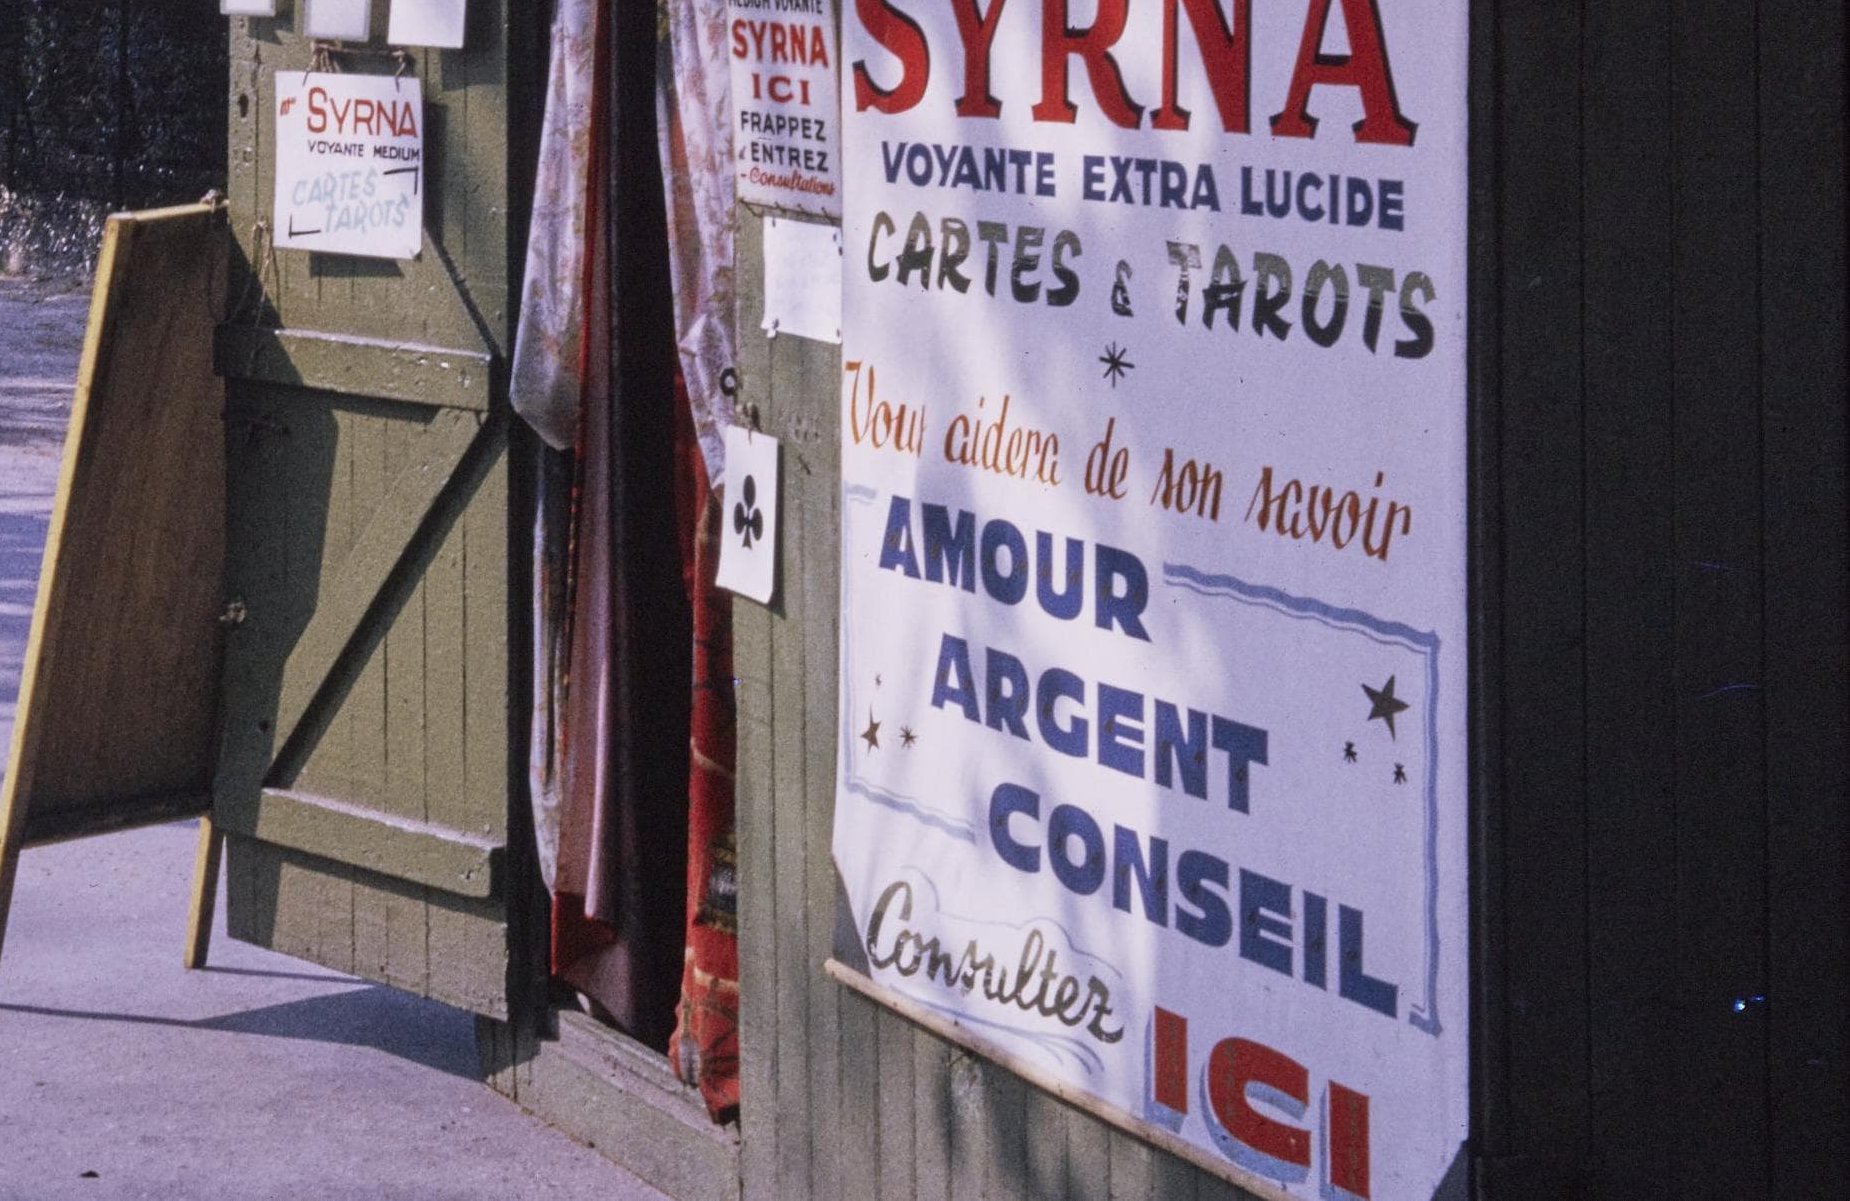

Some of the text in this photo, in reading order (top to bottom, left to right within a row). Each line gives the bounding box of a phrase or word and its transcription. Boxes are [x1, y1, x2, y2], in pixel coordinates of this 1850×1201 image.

[731, 18, 828, 69] SYRNA
[307, 87, 418, 137] SYRNA
[751, 72, 811, 106] ICI
[308, 140, 420, 162] VOYANTE MEDIUM
[740, 110, 827, 142] FRAPPEZ
[750, 141, 829, 172] ENTREZ
[750, 166, 836, 196] Consultations
[295, 169, 378, 207] CARTES
[881, 140, 1405, 231] VOYANTE EXTRA LUCIDE
[325, 193, 409, 234] TAROTS
[867, 210, 1082, 306] CARTES
[1166, 241, 1437, 359] TAROTS
[944, 395, 1061, 485] aidera
[1085, 418, 1129, 499] de
[1151, 447, 1223, 523] son
[1246, 467, 1410, 561] savoir
[878, 496, 1151, 642] AMOUR
[930, 632, 1268, 815] ARGENT
[988, 783, 1398, 1019] CONSEIL
[866, 881, 1124, 1043] Consultez
[1146, 1005, 1371, 1201] ICI
